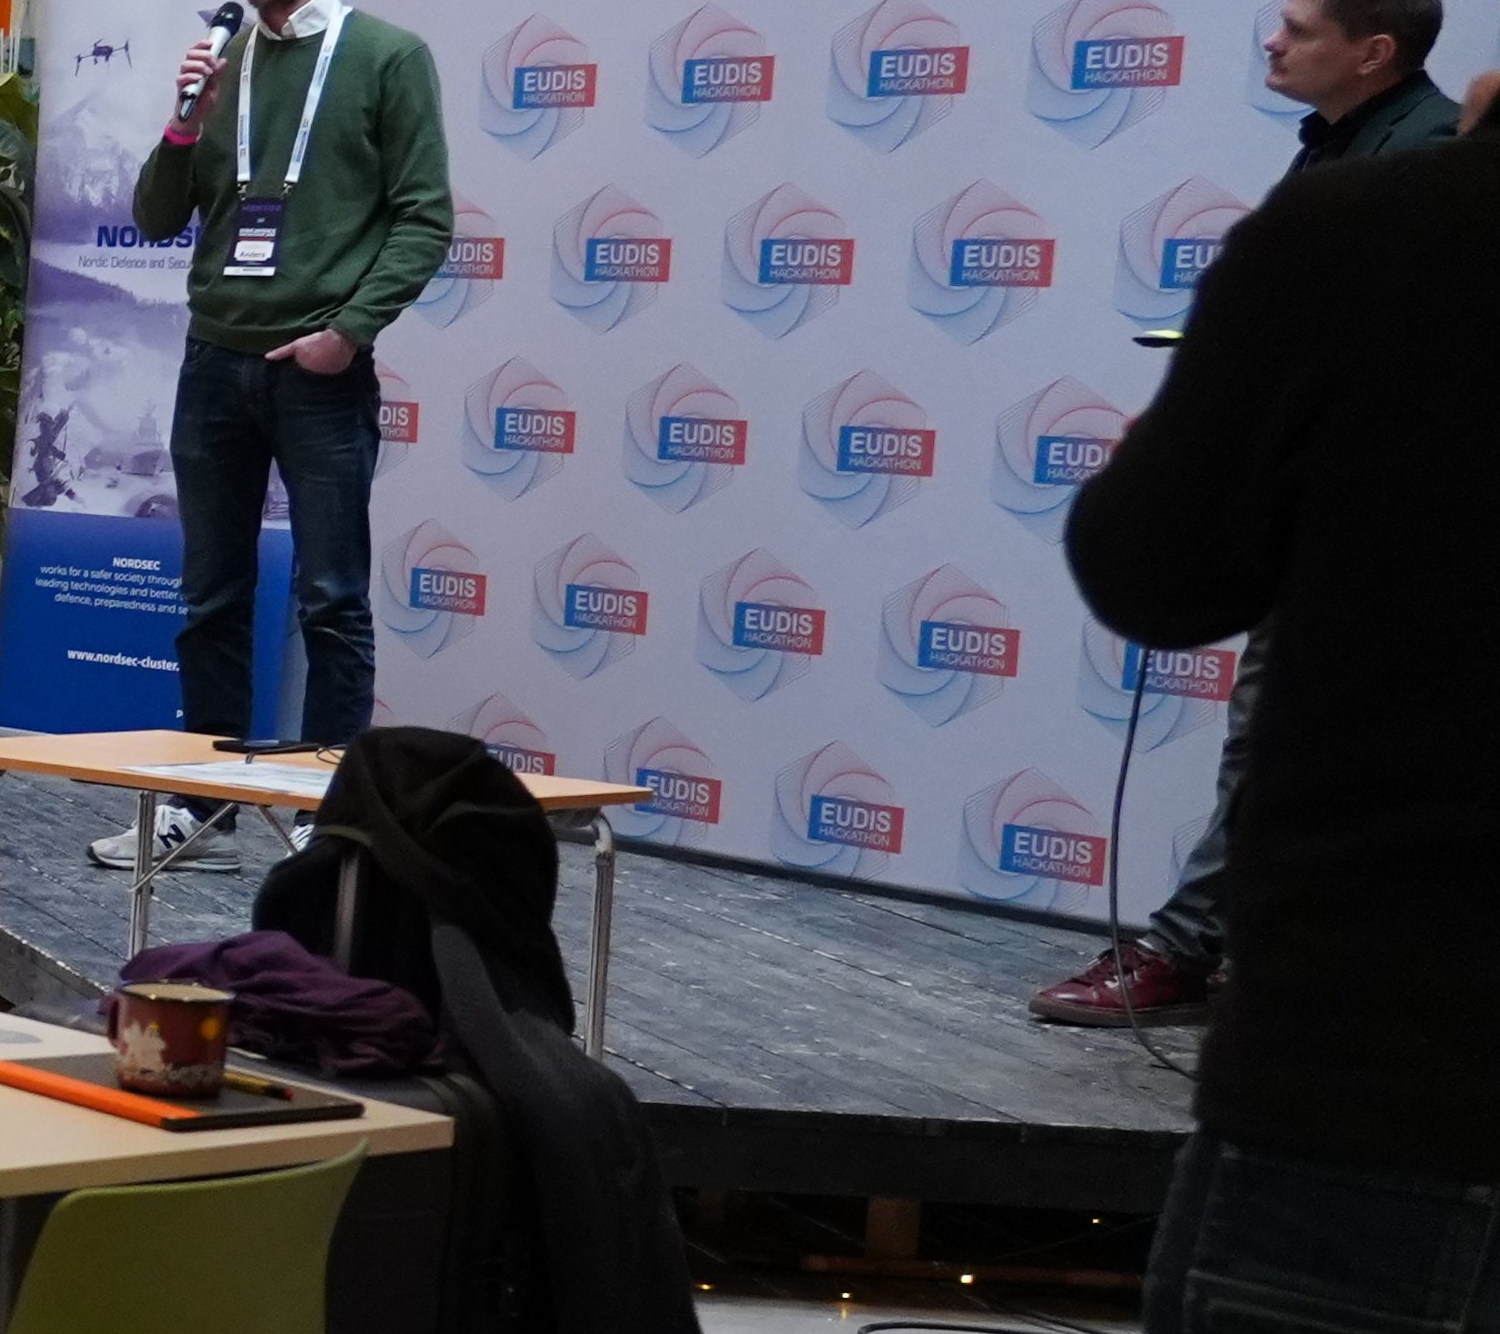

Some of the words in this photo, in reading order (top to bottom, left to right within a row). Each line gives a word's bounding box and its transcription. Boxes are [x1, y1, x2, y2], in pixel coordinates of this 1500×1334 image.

[880, 53, 956, 78] EUDIS
[1086, 42, 1169, 69] EUDIS
[523, 73, 586, 94] EUDIS
[694, 64, 762, 86] EUDIS
[879, 75, 954, 91] HACKATHON
[1084, 69, 1167, 83] HACKATHON
[522, 91, 586, 106] HACKATHON
[693, 85, 761, 99] HACKATHON
[79, 256, 108, 268] Nordic
[111, 256, 147, 269] Defence
[149, 257, 165, 269] and
[168, 256, 193, 270] Secu
[595, 244, 660, 264] EUDIS
[770, 244, 842, 267] EUDIS
[963, 244, 1041, 267] EUDIS
[594, 264, 660, 277] HACKATHON
[769, 267, 841, 280] HACKATHON
[961, 267, 1040, 282] HACKATHON
[504, 411, 565, 436] EUDIS
[669, 421, 735, 445] EUDIS
[504, 433, 565, 449] HACKATHON
[668, 443, 734, 459] HACKATHON
[849, 432, 922, 456] EUDIS
[848, 455, 921, 471] HACKATHON
[113, 557, 160, 570] NORDSEC
[40, 566, 67, 575] works
[69, 566, 80, 577] for
[83, 570, 88, 578] a
[91, 569, 112, 580] safer
[114, 573, 146, 586] society
[419, 574, 477, 598] EUDIS
[35, 578, 68, 591] leading
[70, 581, 128, 596] technologies
[130, 586, 147, 597] and
[150, 588, 178, 600] better
[55, 592, 93, 606] defence,
[94, 597, 156, 612] preparedness
[158, 603, 176, 614] and
[418, 592, 476, 611] HACKATHON
[575, 591, 637, 616] EUDIS
[574, 611, 636, 630] HACKATHON
[745, 609, 814, 634] EUDIS
[743, 629, 813, 649] HACKATHON
[931, 628, 1006, 654] EUDIS
[67, 649, 180, 672] www.nordsec-cluster.
[929, 651, 1005, 670] HACKATHON
[820, 802, 891, 833] EUDIS
[819, 826, 890, 847] HACKATHON
[1015, 832, 1093, 864] EUDIS
[1013, 857, 1091, 878] HACKATHON
